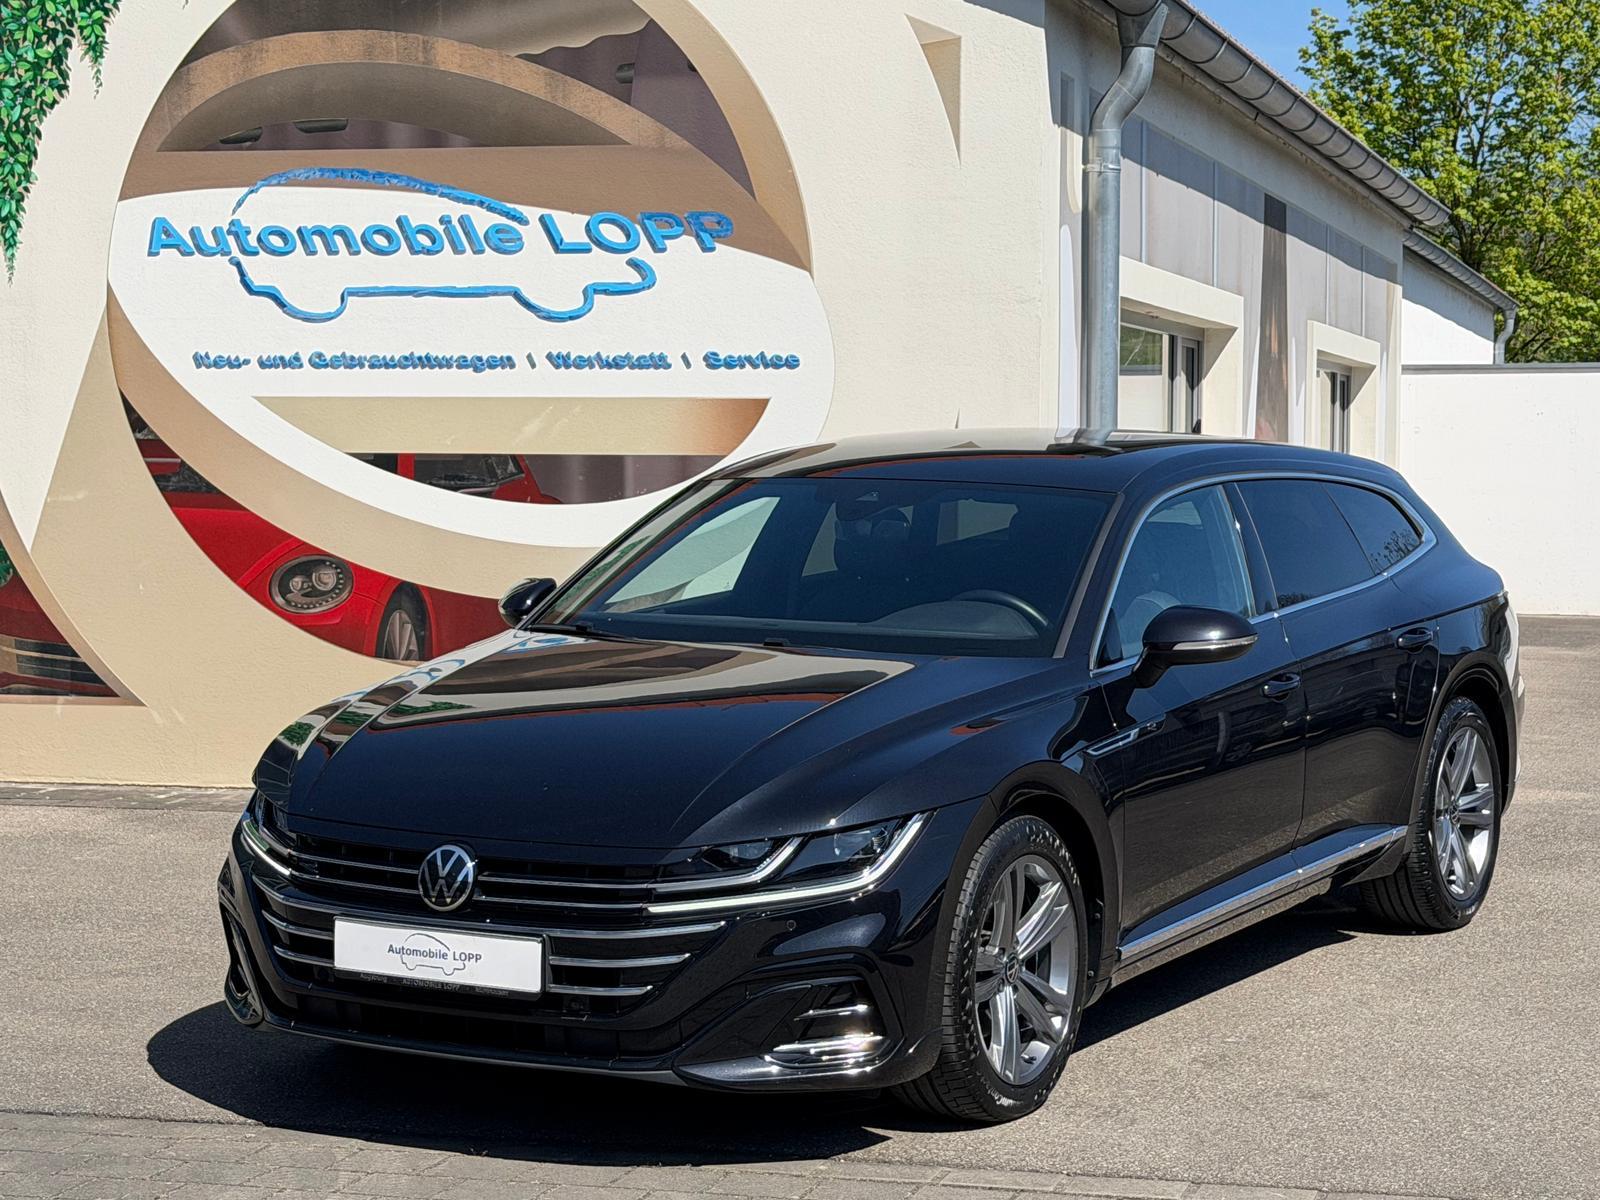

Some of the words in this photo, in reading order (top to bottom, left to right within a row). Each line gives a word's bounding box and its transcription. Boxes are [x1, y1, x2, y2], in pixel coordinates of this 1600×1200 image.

[147, 214, 526, 258] Automobile
[538, 211, 734, 254] LOPP
[192, 351, 252, 369] Neu-
[257, 352, 304, 369] und
[308, 351, 517, 374] Gebrauchtwagen
[545, 351, 673, 370] Werkstatt
[703, 351, 801, 370] Service
[387, 943, 449, 960] Automobile
[453, 951, 482, 963] LOPP
